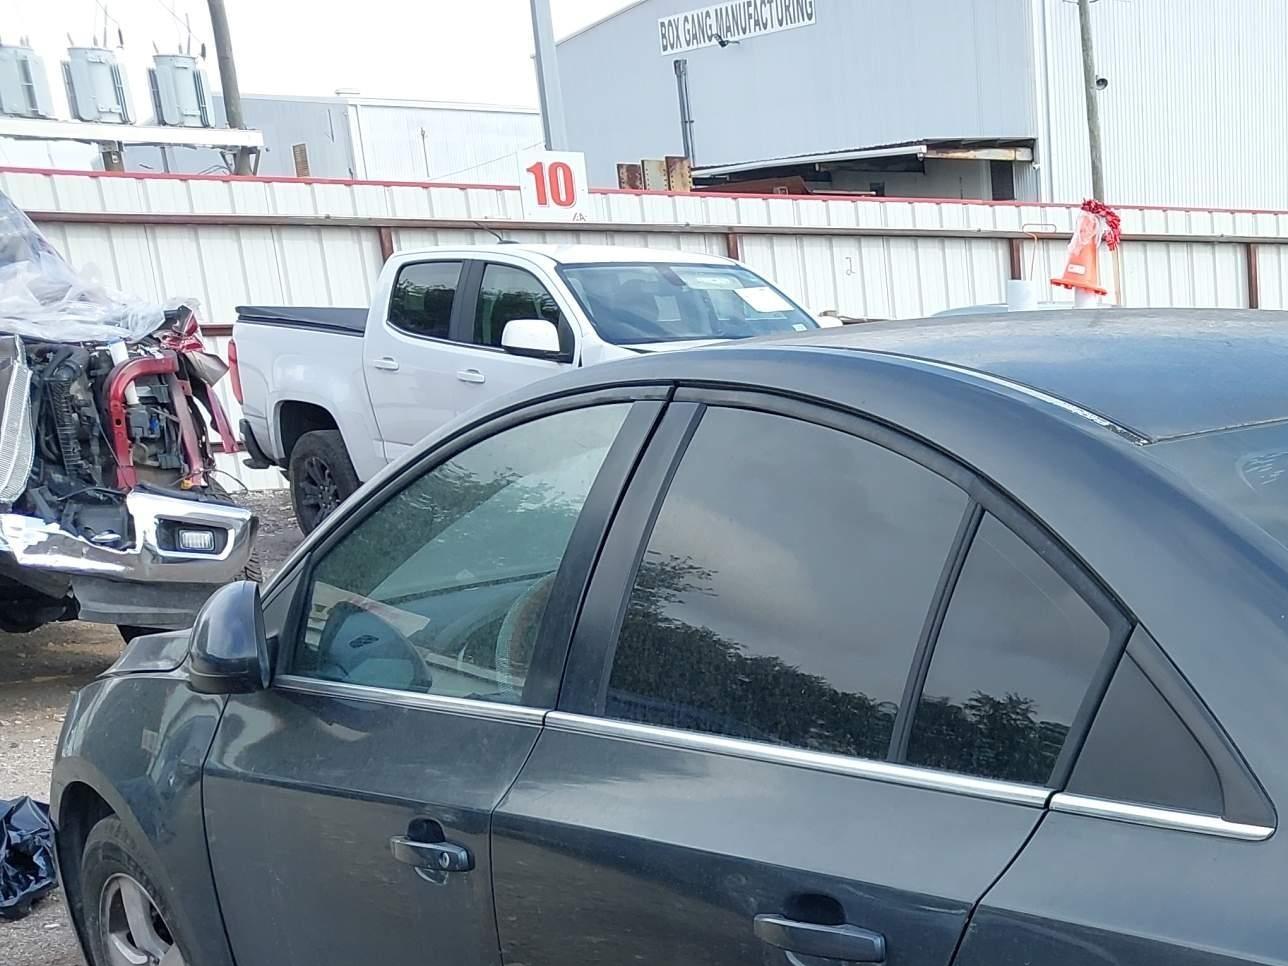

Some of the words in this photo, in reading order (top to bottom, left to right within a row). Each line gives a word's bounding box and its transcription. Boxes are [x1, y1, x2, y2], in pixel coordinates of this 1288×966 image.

[659, 16, 683, 52] BOX
[683, 10, 713, 48] GANG
[714, 0, 814, 39] MANUFACTURING
[526, 161, 576, 208] 10
